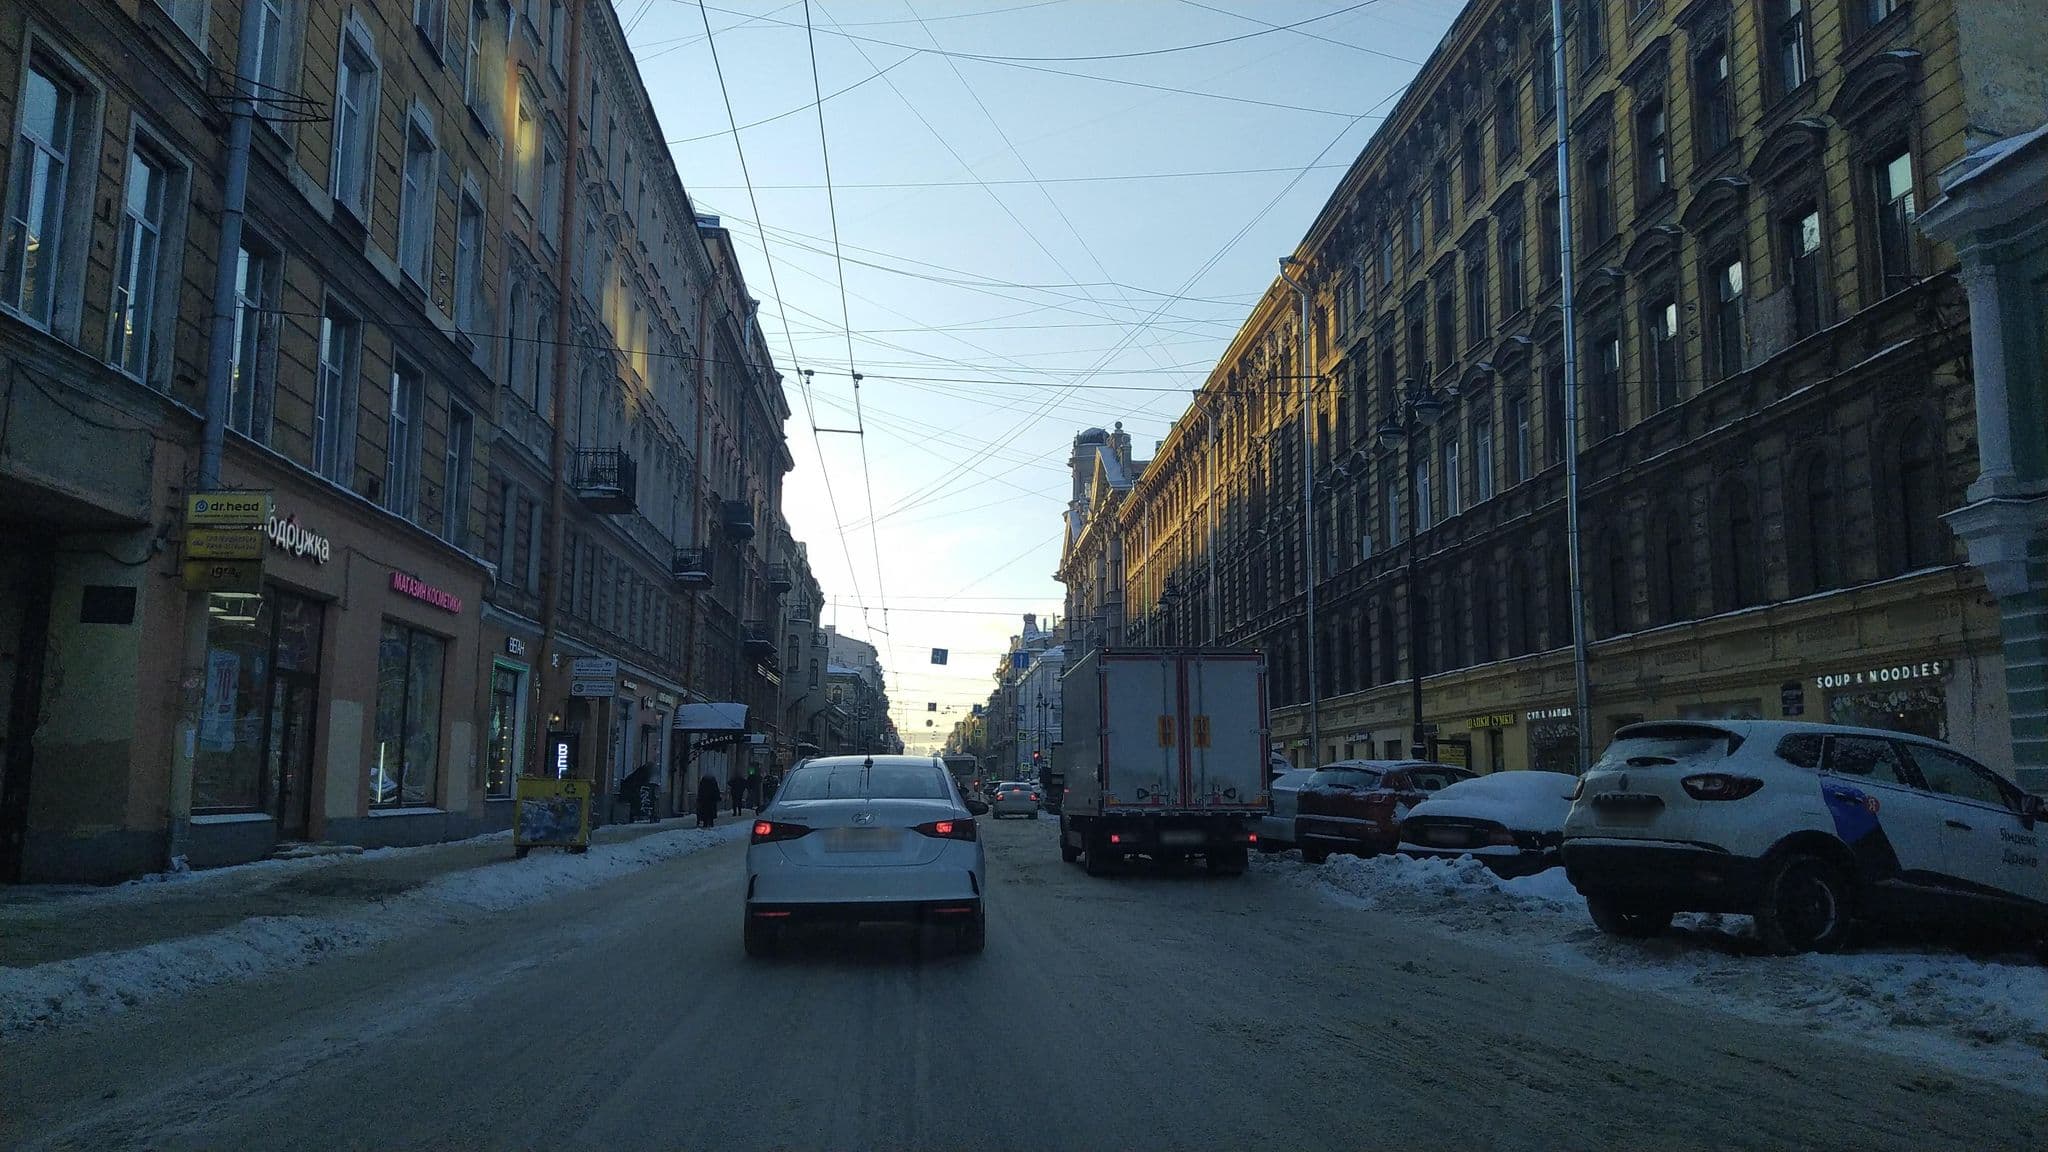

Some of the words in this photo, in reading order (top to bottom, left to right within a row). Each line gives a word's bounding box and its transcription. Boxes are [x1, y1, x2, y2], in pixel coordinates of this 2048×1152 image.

[210, 502, 259, 512] dr.head
[393, 572, 427, 599] МАГАЗИН
[1816, 673, 1850, 688] SOUP
[1856, 672, 1863, 683] &
[1869, 661, 1940, 682] NOODLES
[2000, 828, 2038, 847] Яндекс
